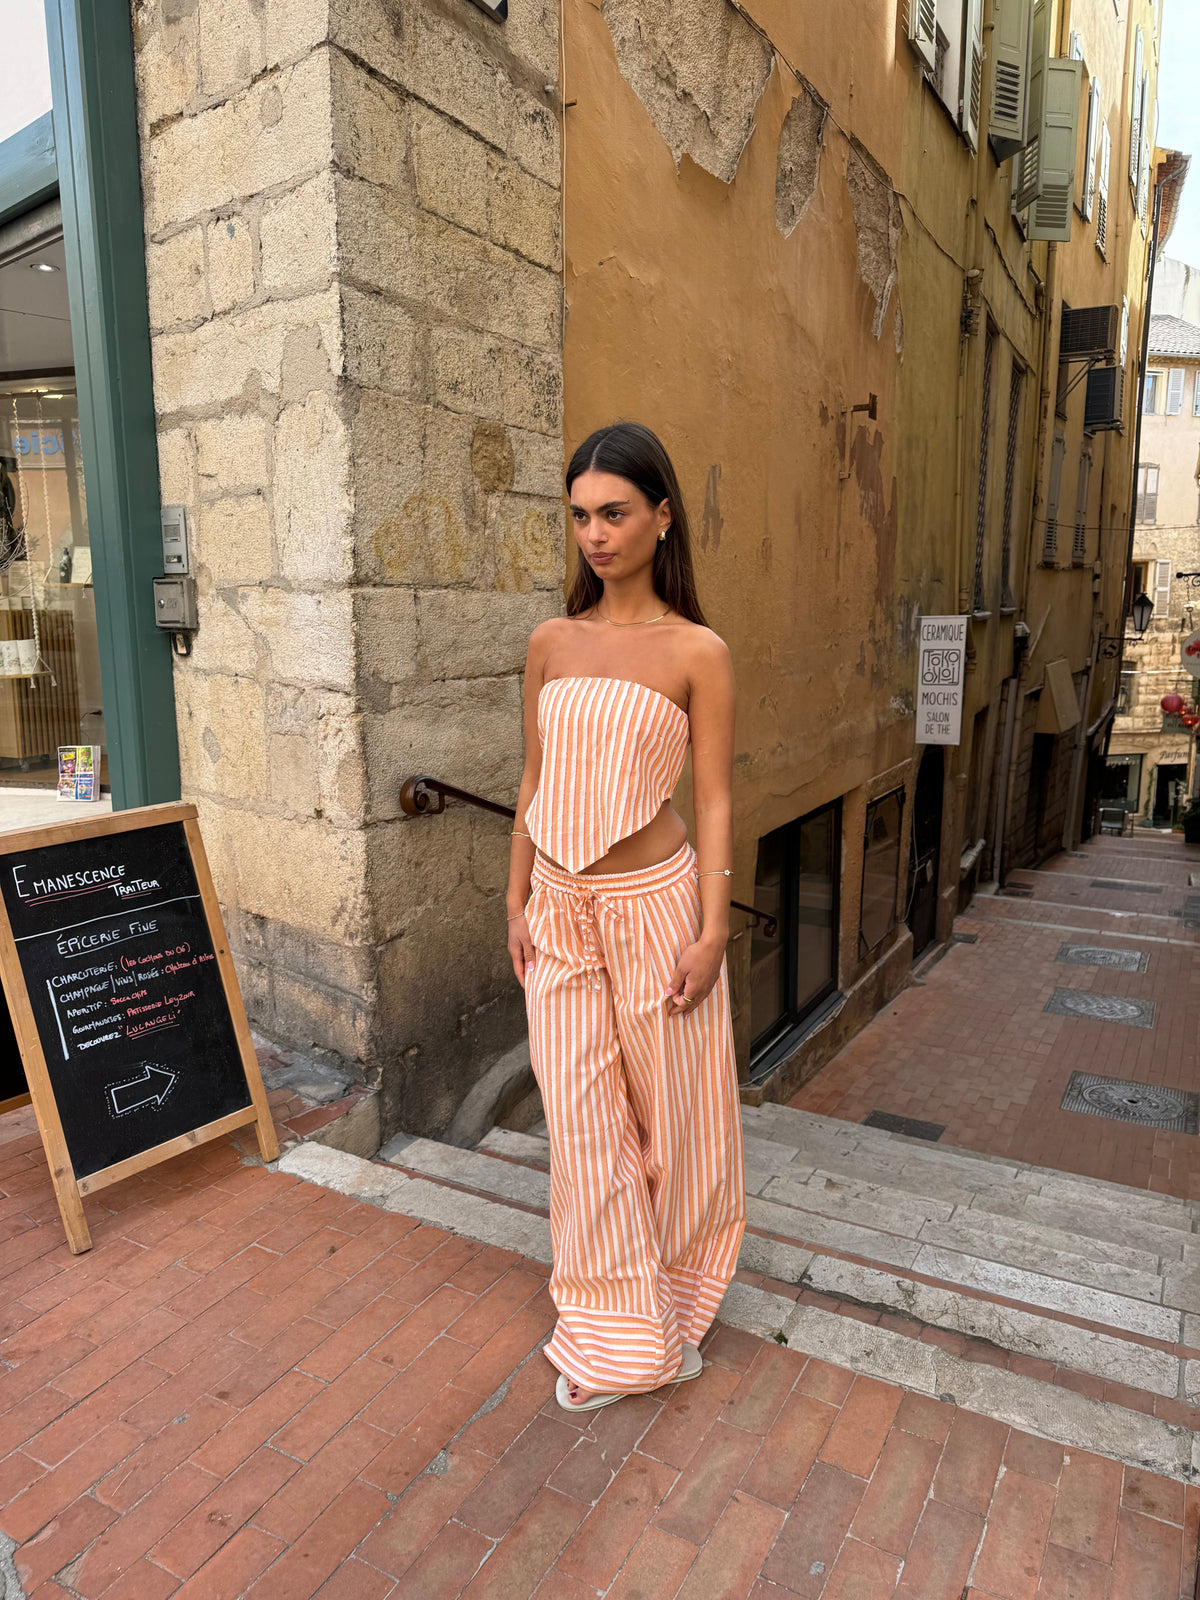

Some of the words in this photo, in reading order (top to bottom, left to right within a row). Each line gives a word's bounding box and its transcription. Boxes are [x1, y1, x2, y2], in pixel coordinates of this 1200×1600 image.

[921, 624, 964, 642] CERAMIQUE
[921, 691, 959, 706] MOCHIS
[926, 711, 950, 722] SALON
[924, 723, 935, 735] DE
[937, 723, 951, 735] THE
